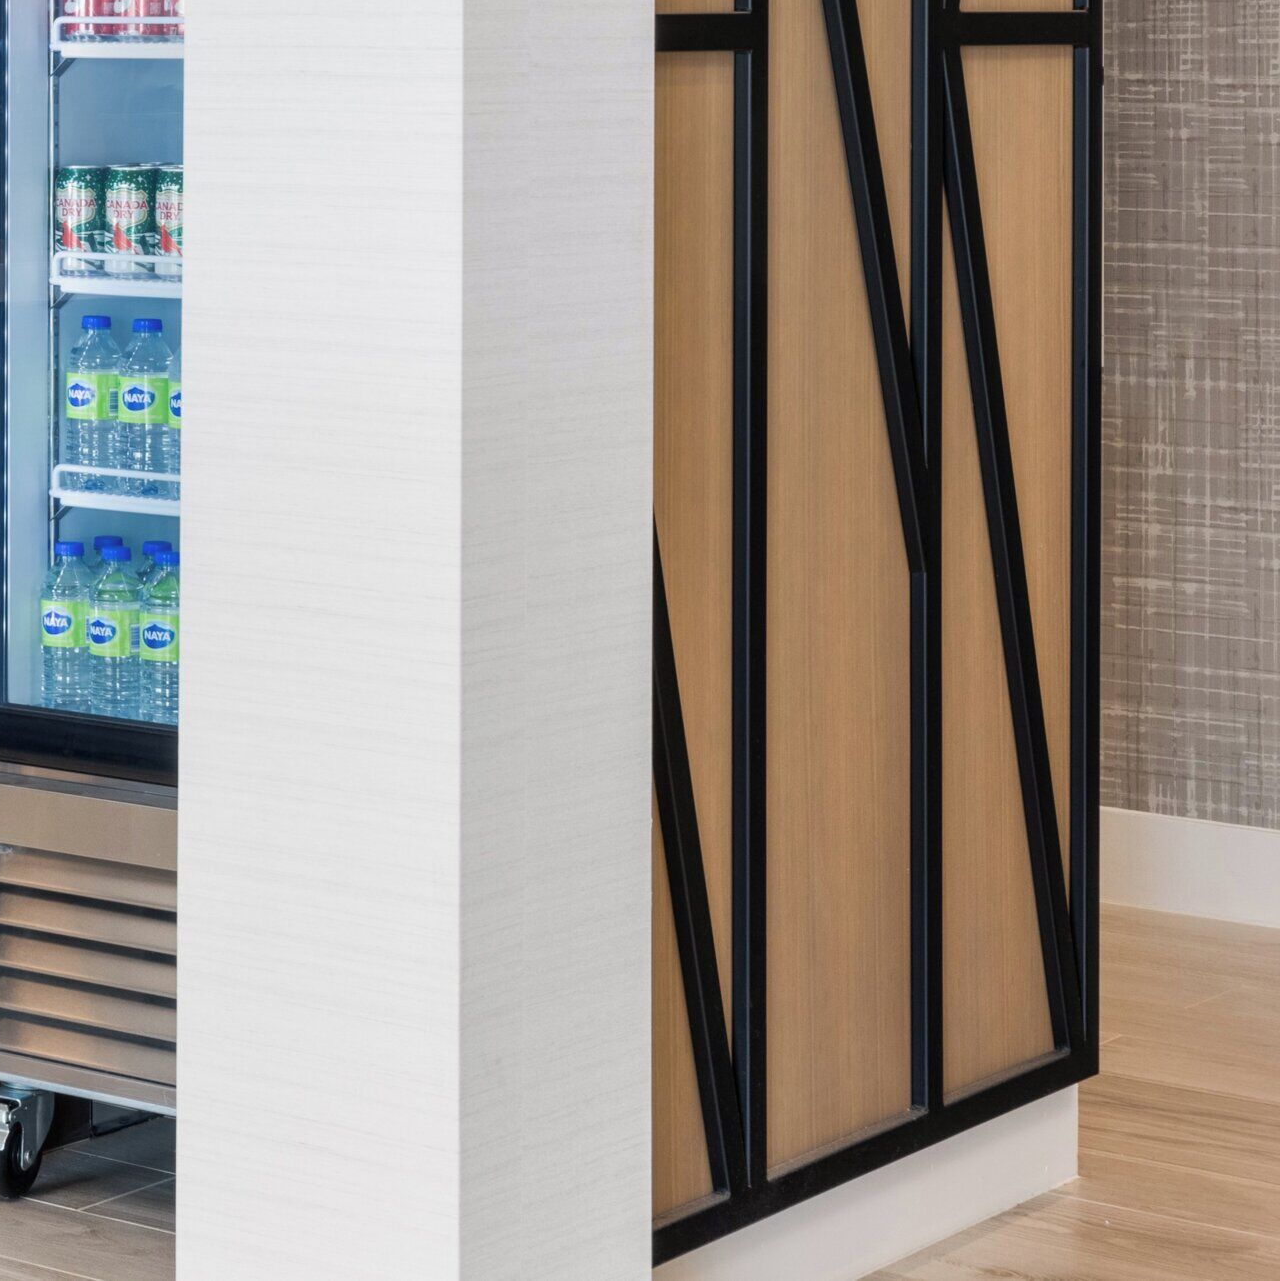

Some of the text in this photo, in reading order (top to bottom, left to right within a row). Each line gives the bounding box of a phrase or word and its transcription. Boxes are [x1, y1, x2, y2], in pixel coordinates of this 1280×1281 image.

[156, 202, 183, 211] ANAD
[61, 208, 82, 217] DRY
[113, 209, 134, 219] DRY
[160, 212, 182, 221] DRY
[68, 388, 92, 400] NAYA
[124, 393, 152, 404] NAYA
[171, 399, 181, 408] NA
[43, 616, 69, 628] NAYA
[90, 625, 113, 637] NAYA
[144, 630, 170, 641] NAYA
